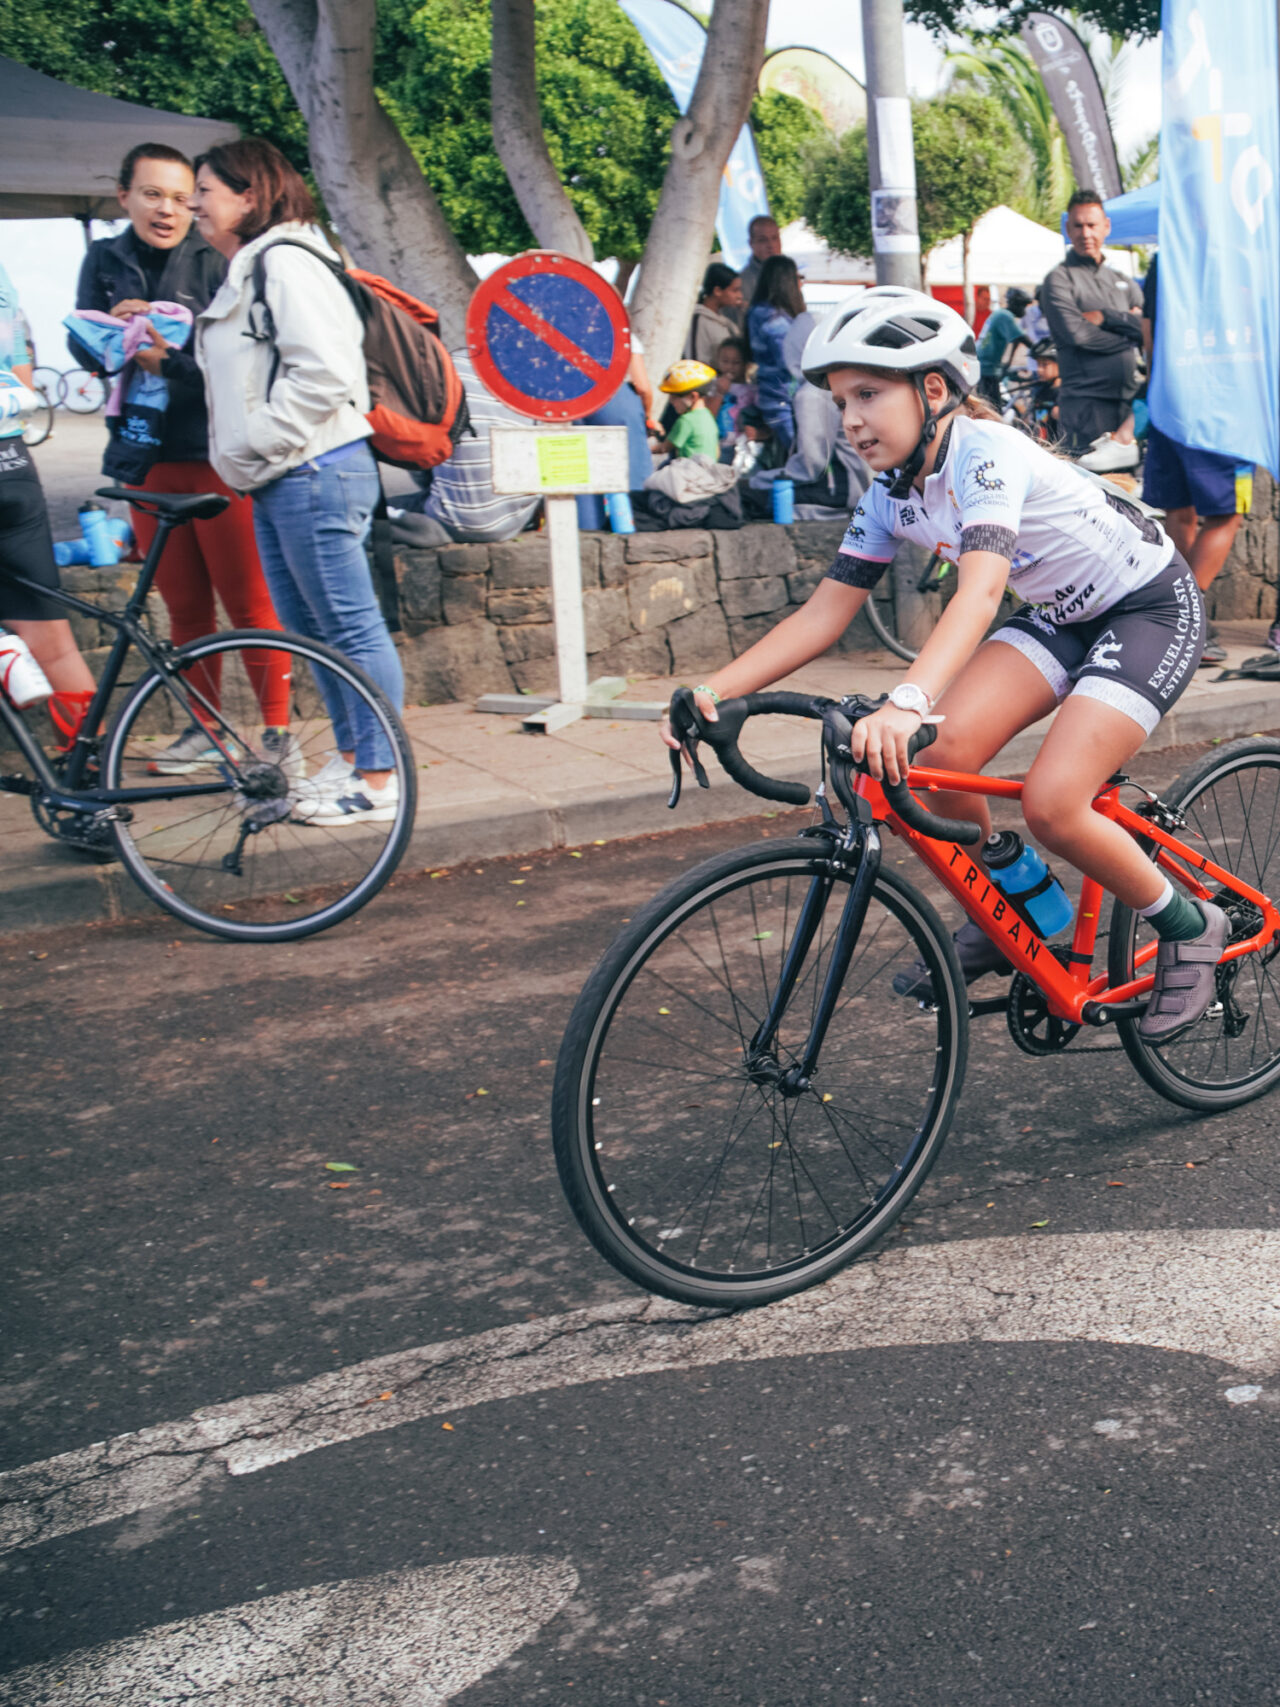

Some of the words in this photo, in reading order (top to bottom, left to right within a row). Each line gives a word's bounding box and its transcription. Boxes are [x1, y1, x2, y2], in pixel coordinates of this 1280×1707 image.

[1054, 583, 1096, 622] Hoya
[1160, 641, 1196, 700] ESTEBAN
[1185, 572, 1201, 641] CARDONA
[1147, 634, 1186, 689] ESCUELA
[949, 845, 1041, 962] TRIBAN
